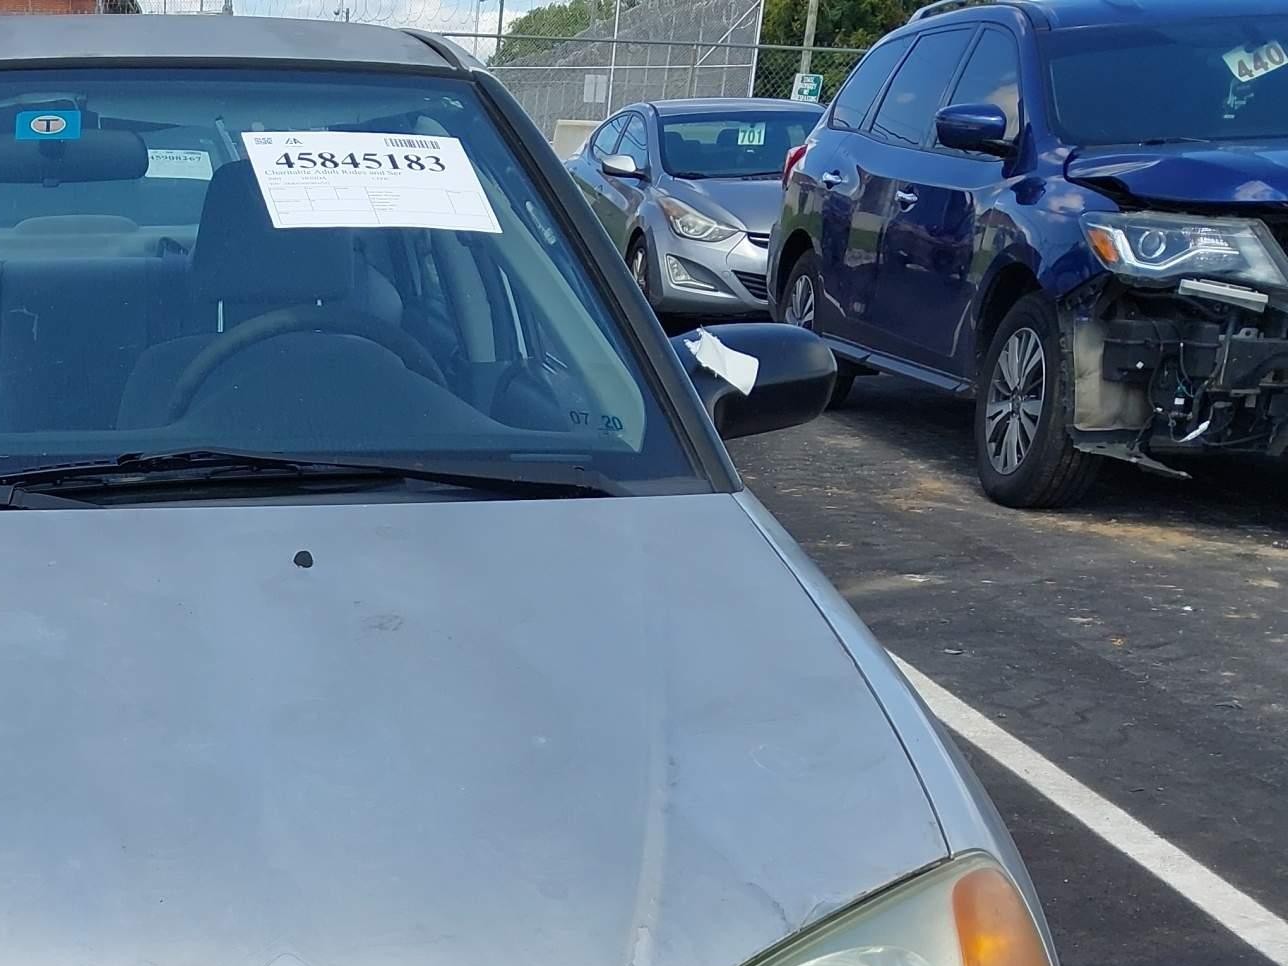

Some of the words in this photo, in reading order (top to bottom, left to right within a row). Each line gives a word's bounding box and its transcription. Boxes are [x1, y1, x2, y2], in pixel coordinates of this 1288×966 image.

[1237, 44, 1285, 78] 440
[740, 129, 763, 145] 701
[275, 151, 447, 173] 45845183
[569, 410, 589, 425] 07
[601, 414, 624, 431] 20
